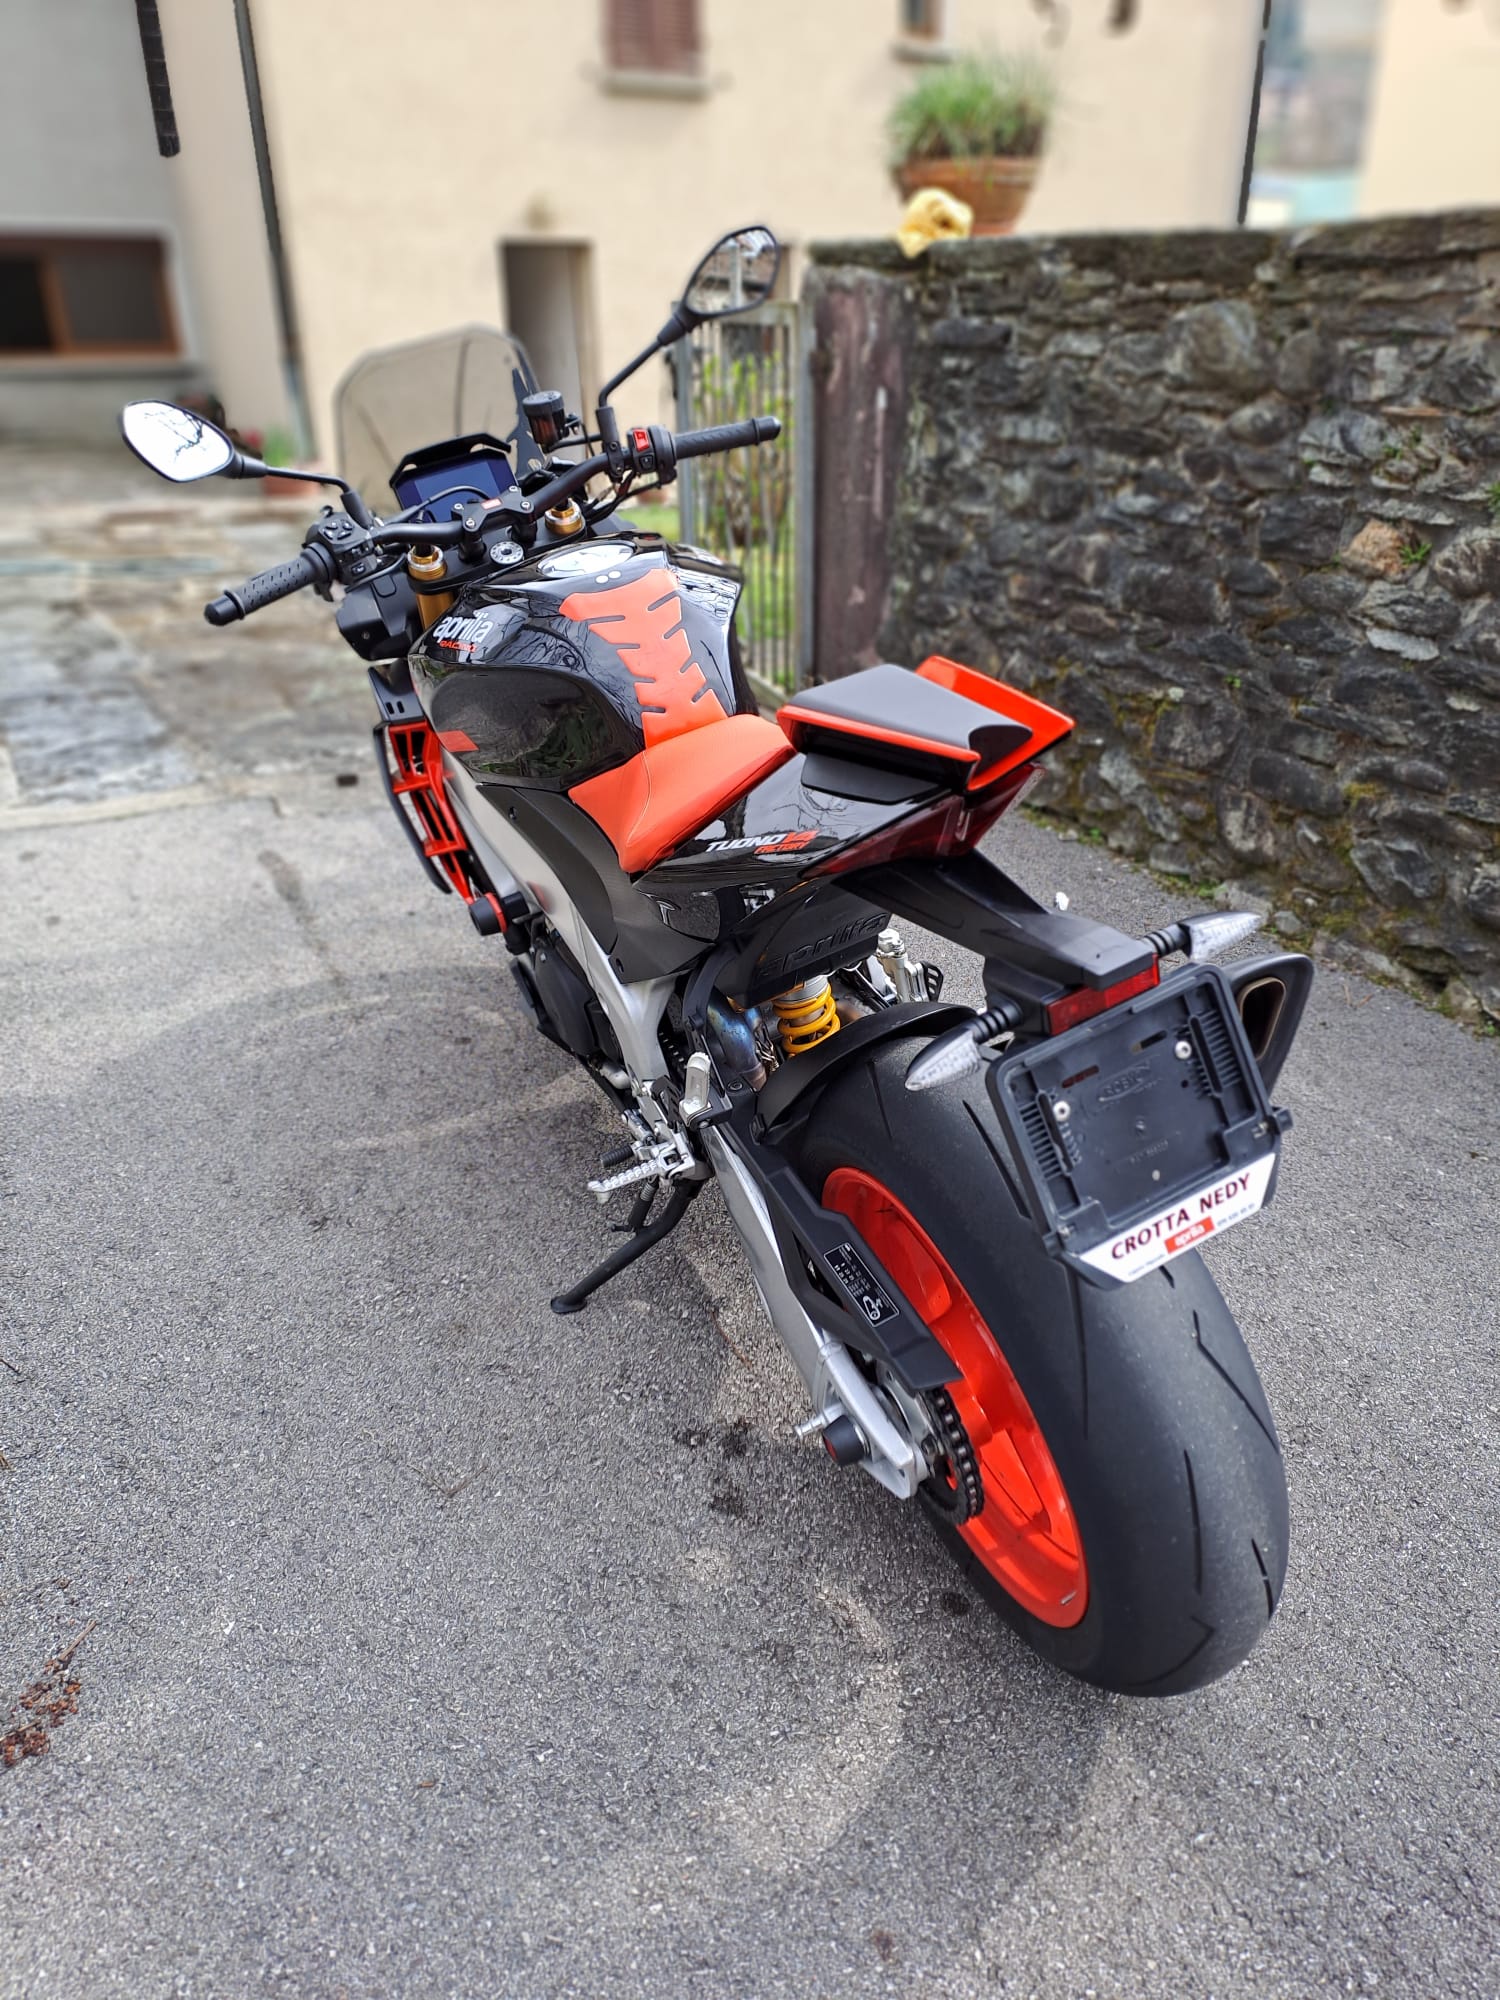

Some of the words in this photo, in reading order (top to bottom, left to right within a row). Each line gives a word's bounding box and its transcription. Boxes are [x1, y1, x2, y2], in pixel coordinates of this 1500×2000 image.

[432, 611, 493, 643] aprilia
[705, 833, 788, 852] TUONO
[1111, 1207, 1190, 1260] CROTTA
[1199, 1172, 1250, 1213] NEDY
[1174, 1223, 1206, 1247] aprilia
